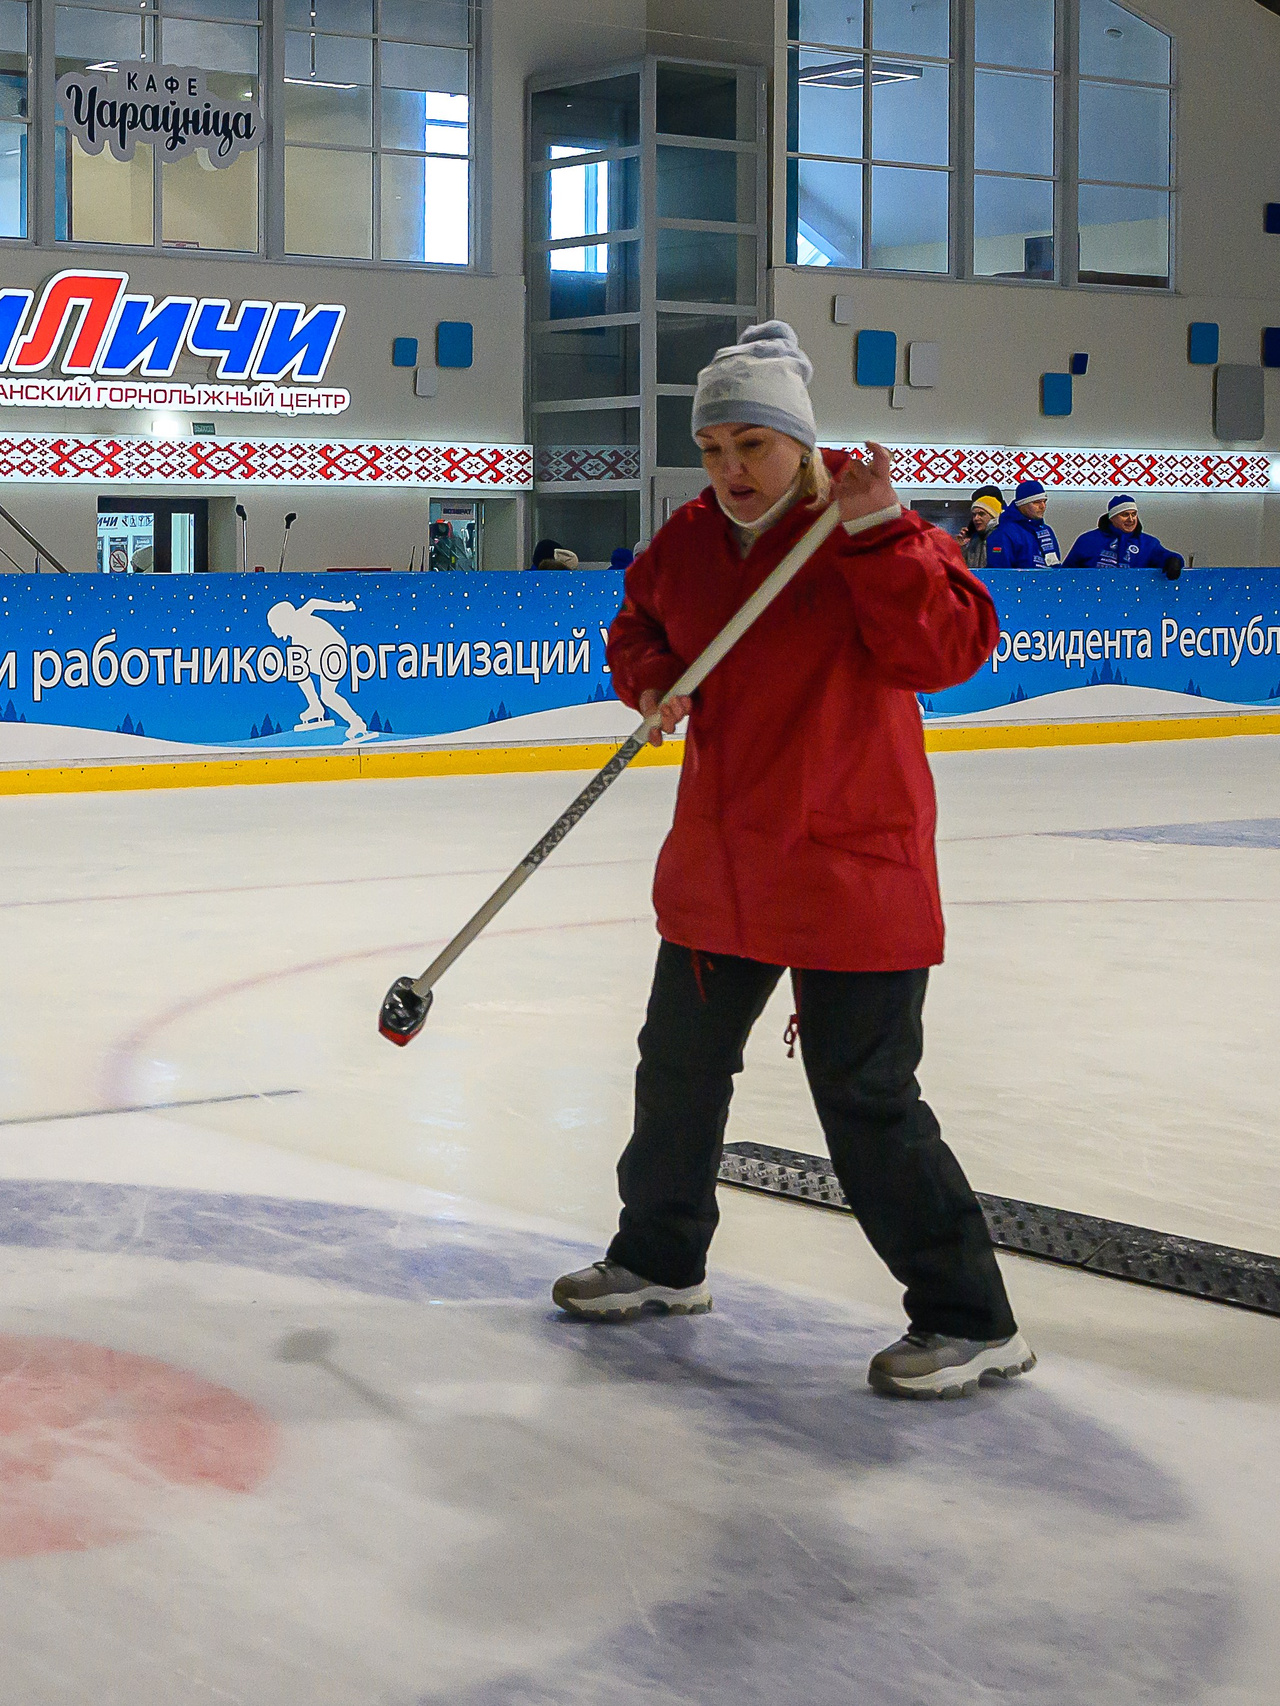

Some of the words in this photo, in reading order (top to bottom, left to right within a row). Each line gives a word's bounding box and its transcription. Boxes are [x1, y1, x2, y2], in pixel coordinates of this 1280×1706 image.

[127, 72, 197, 96] КАФЕ
[65, 84, 257, 157] Чараўніца
[96, 386, 274, 408] ГОРНОЛЫЖНЫЙ
[280, 393, 346, 410] ЦЕНТР
[32, 633, 311, 703] работников
[320, 627, 592, 694] организаций
[986, 629, 1152, 673] резидента
